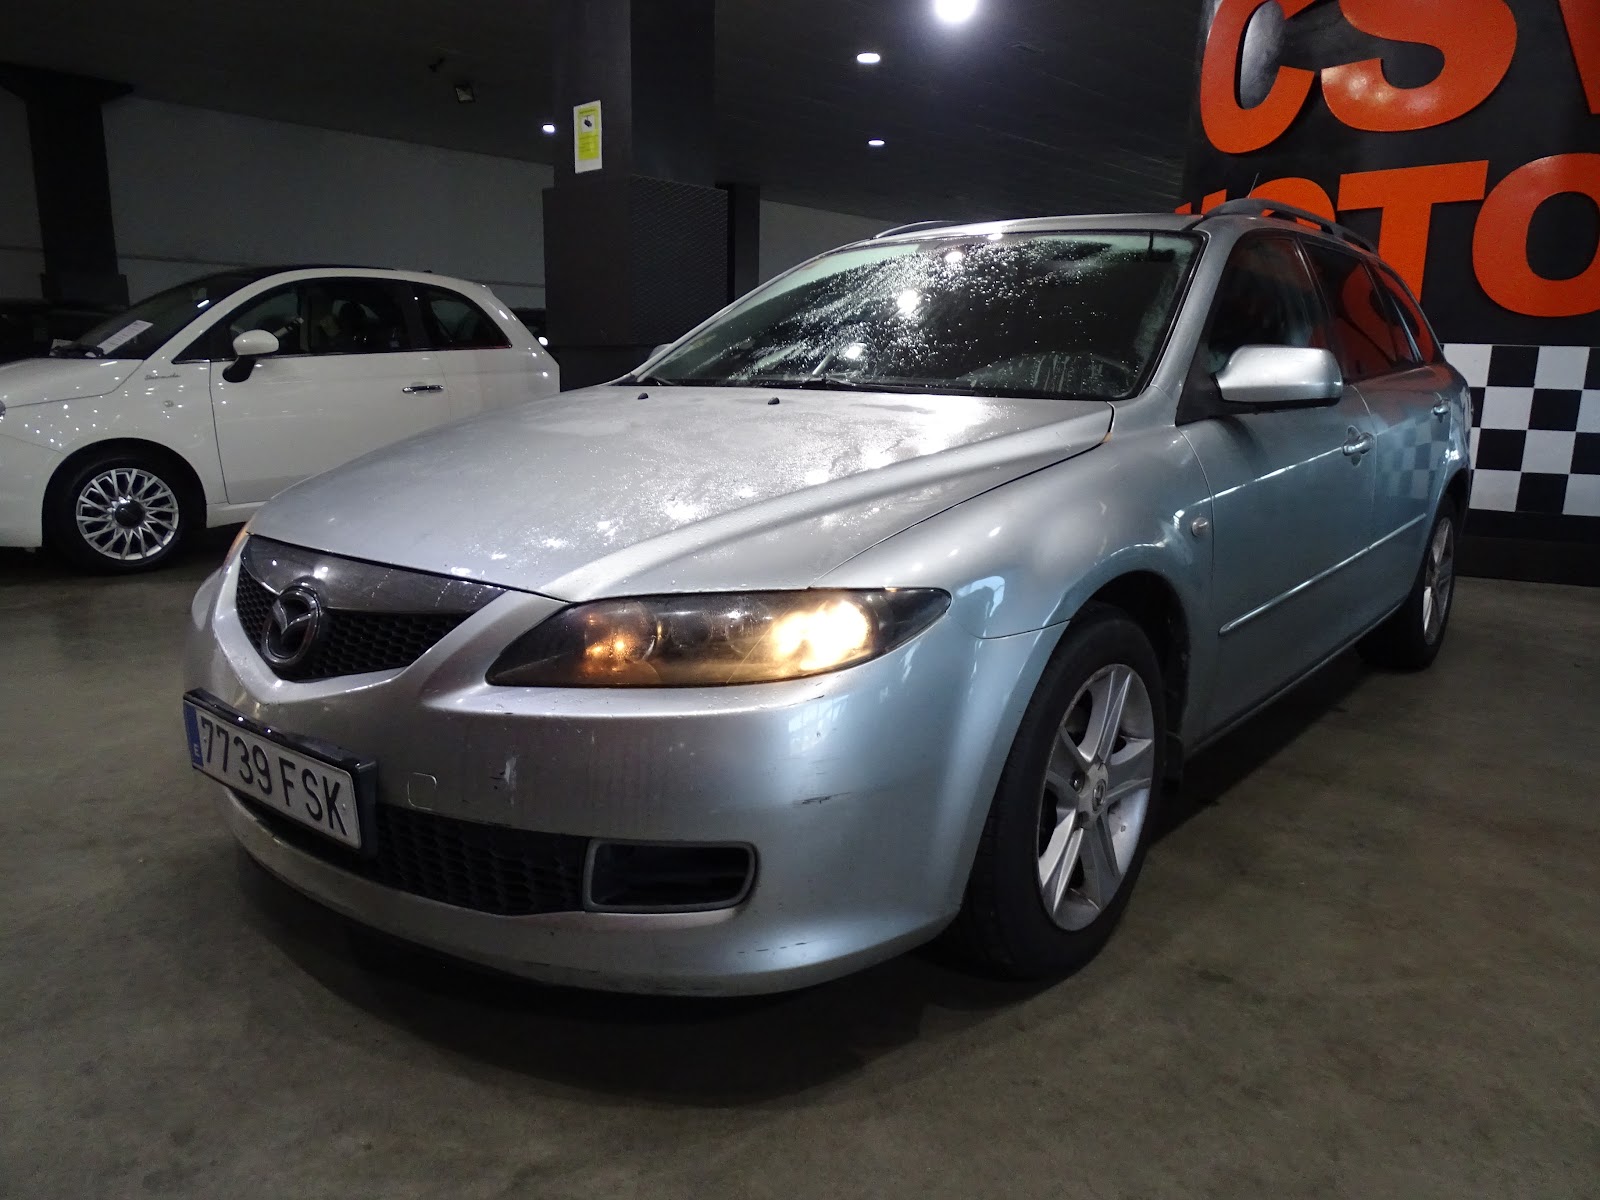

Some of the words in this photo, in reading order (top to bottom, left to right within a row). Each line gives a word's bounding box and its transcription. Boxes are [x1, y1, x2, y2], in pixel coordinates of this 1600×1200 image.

[1174, 153, 1600, 318] TO
[201, 716, 273, 795] 7739
[279, 756, 348, 836] FSK
